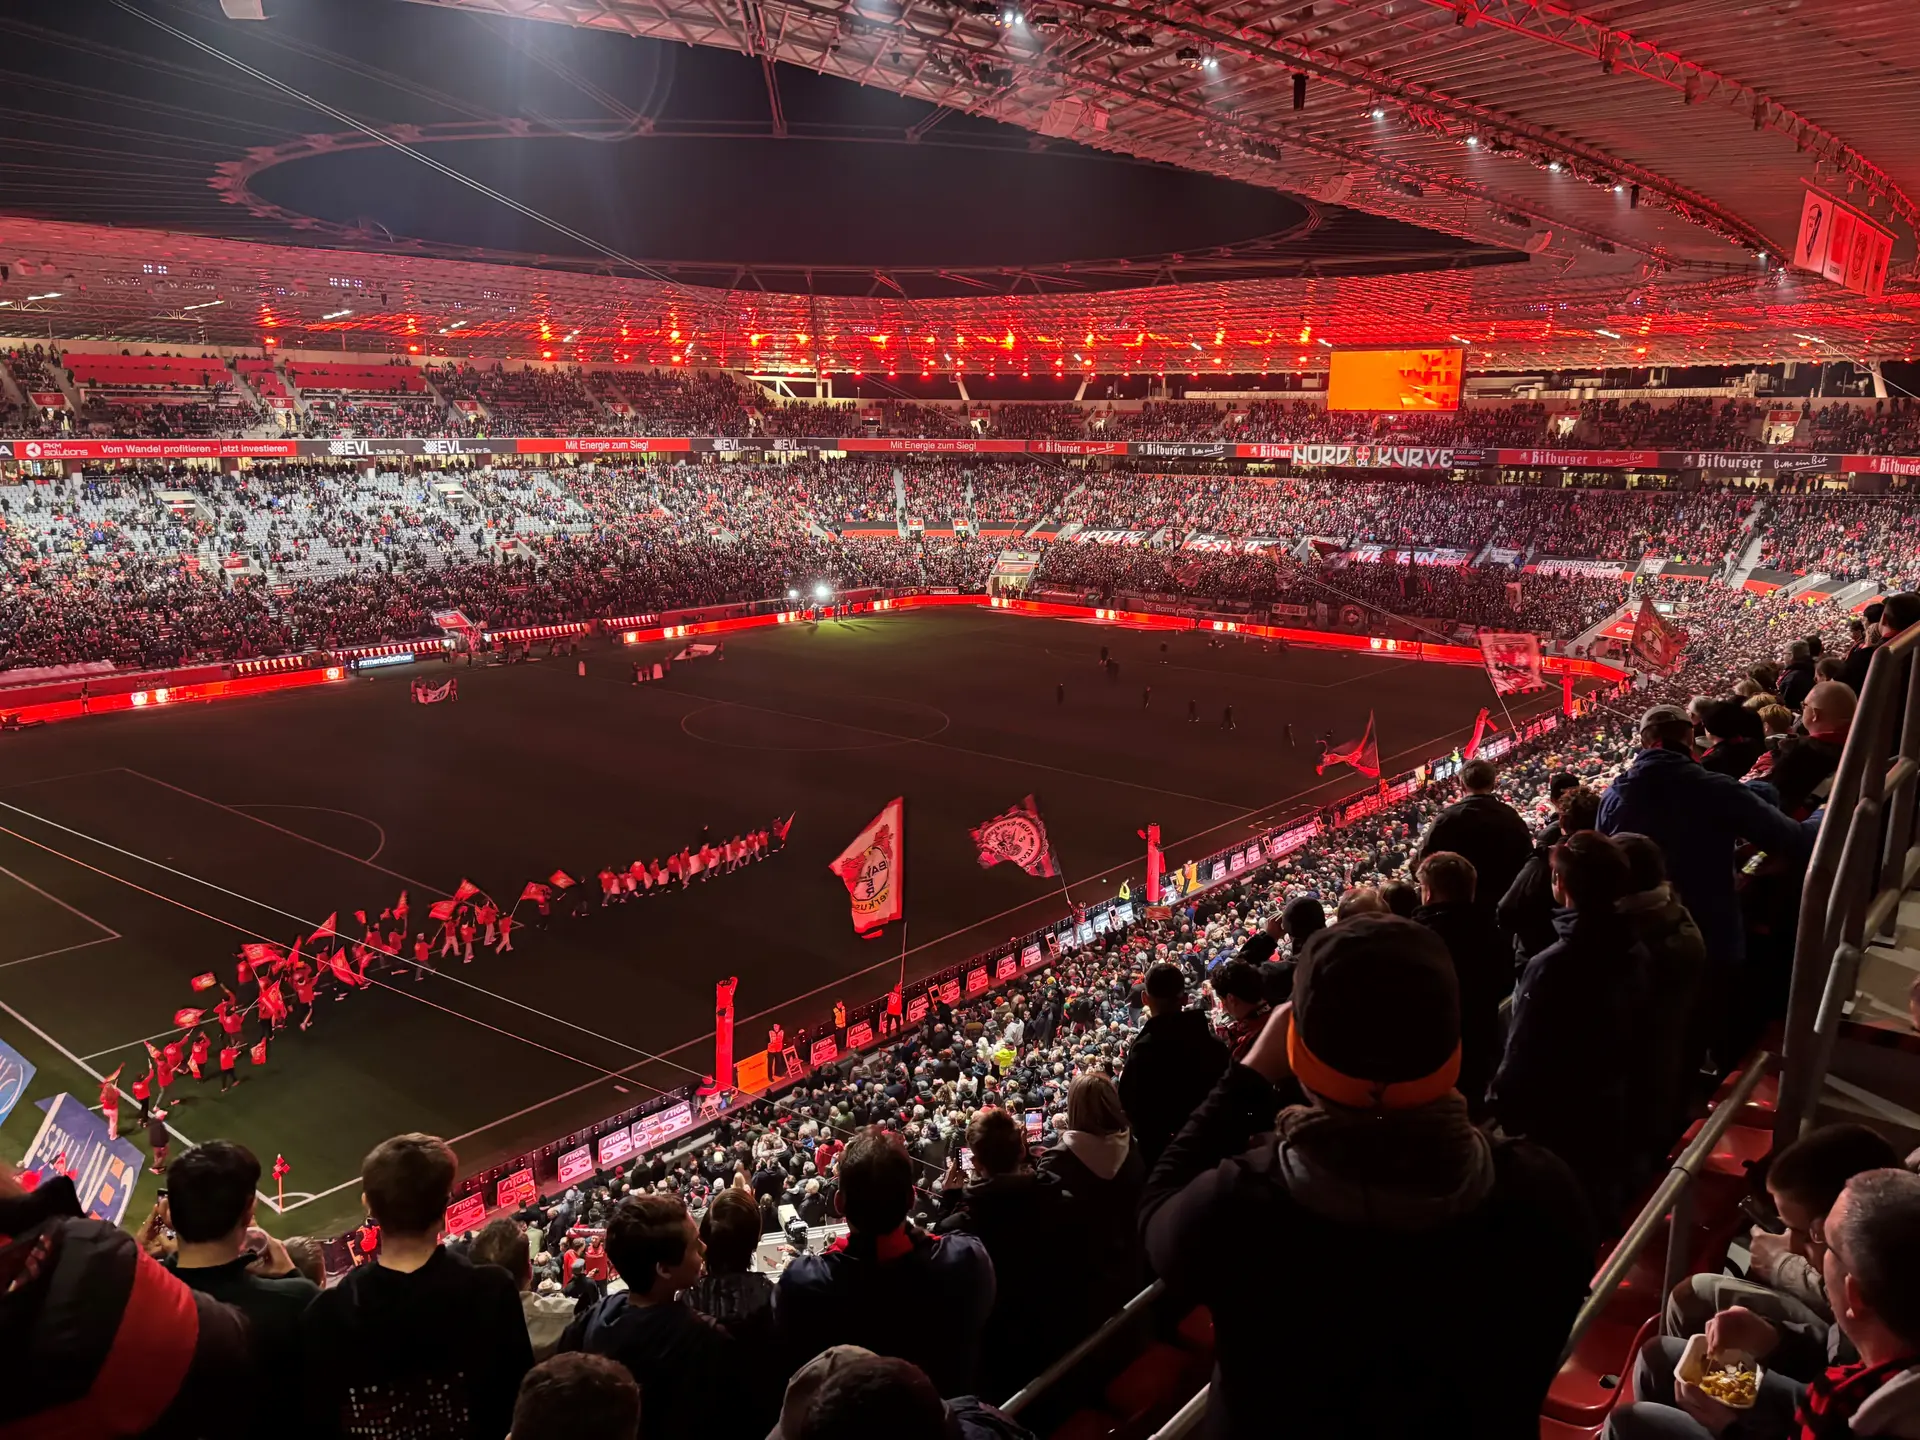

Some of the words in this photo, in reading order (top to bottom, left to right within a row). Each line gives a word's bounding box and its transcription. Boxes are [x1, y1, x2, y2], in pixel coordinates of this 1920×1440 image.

[101, 445, 123, 453] Vom
[126, 445, 161, 453] Wandel
[164, 445, 210, 454] profitieren
[345, 441, 374, 455] EVL
[437, 441, 464, 453] EVL
[565, 441, 578, 449] Mit
[580, 441, 610, 451] Energie
[630, 441, 649, 451] Sieg!
[782, 440, 799, 450] EVL
[890, 441, 903, 449] Mit
[905, 441, 935, 451] Energie
[956, 442, 976, 451] Sieg!
[1045, 442, 1080, 453] Bitburger
[1146, 444, 1186, 455] Bitburger
[44, 448, 88, 456] solutions
[1293, 445, 1350, 465] NORD
[1356, 459, 1368, 467] 04
[1377, 447, 1454, 468] KURVE
[1531, 451, 1588, 465] Bitburger
[1697, 454, 1763, 469] Bitburger
[1774, 460, 1793, 469] Bitte
[1811, 455, 1828, 465] Bit
[1541, 560, 1618, 569] LEIDENSCHAFT
[890, 994, 898, 1004] 10
[911, 996, 927, 1009] STIGA
[851, 1022, 870, 1035] STIGA
[816, 1038, 833, 1050] STIGA
[664, 1104, 688, 1120] STIGA
[602, 1132, 628, 1147] STIGA
[563, 1149, 586, 1163] STIGA
[452, 1198, 478, 1214] STIGA
